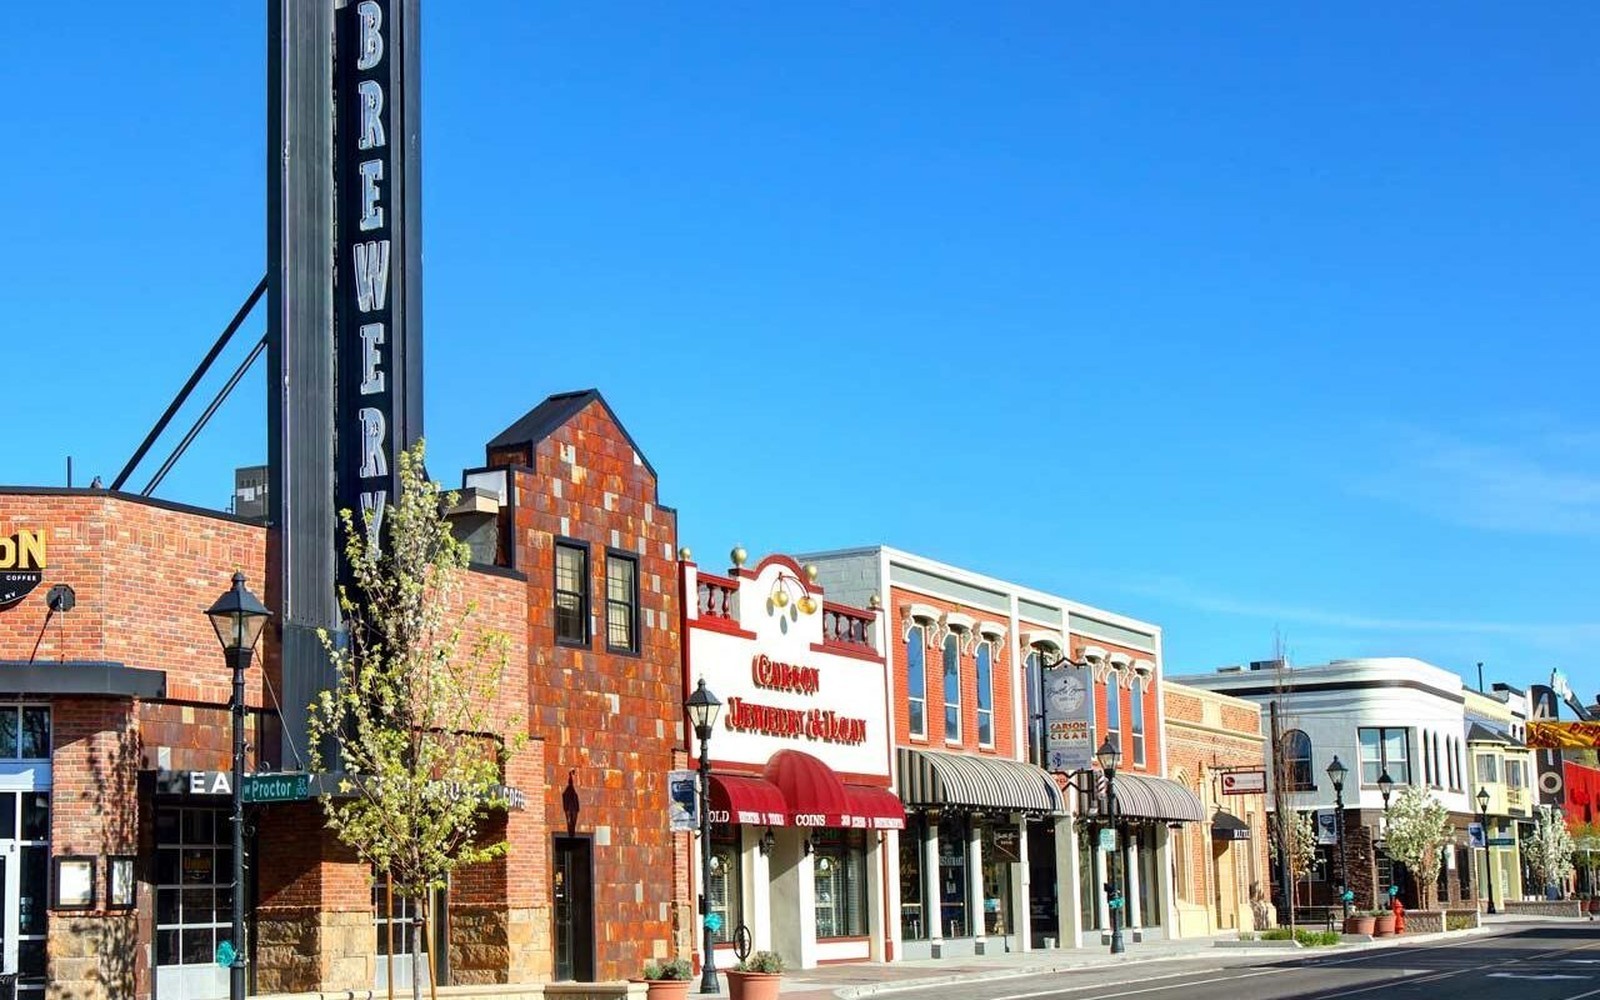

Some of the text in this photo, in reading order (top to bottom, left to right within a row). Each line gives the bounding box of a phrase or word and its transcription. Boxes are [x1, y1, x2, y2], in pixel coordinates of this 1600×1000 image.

[353, 0, 391, 561] BREWERY
[1050, 721, 1088, 731] CARSON
[1050, 731, 1088, 740] CIGAR
[252, 779, 291, 798] Proctor
[795, 813, 826, 827] COINS
